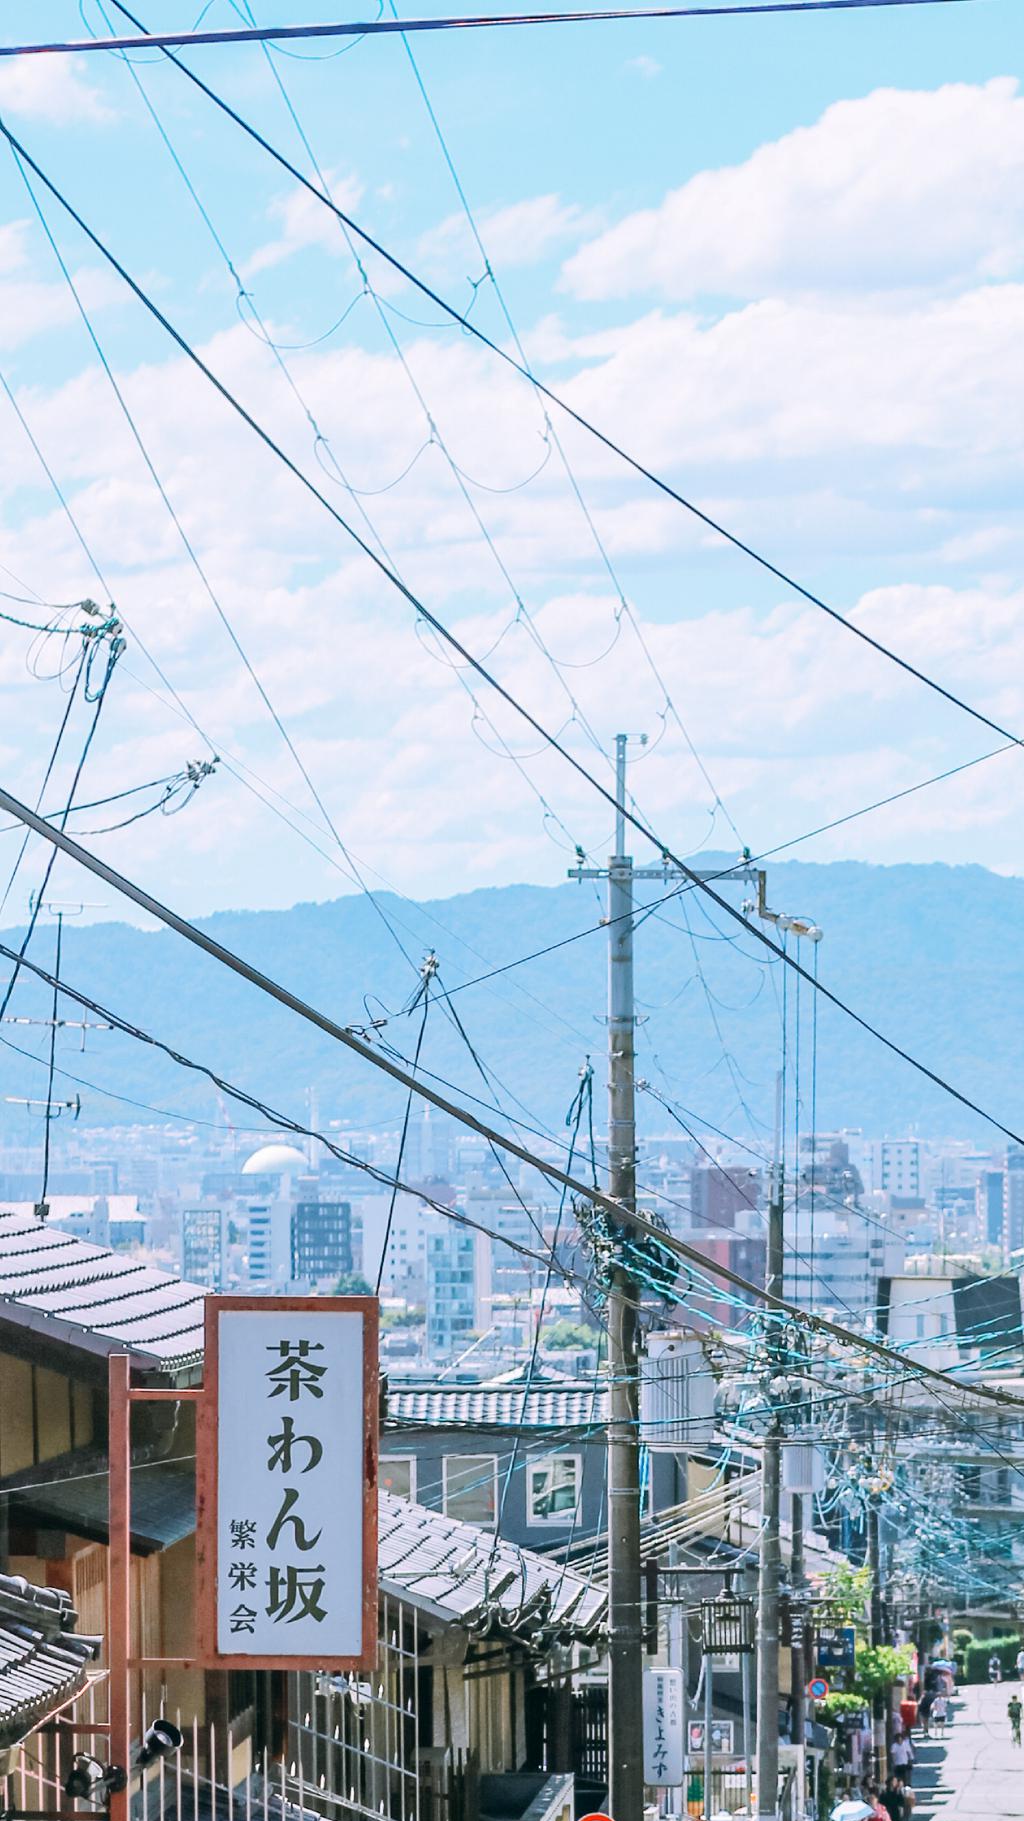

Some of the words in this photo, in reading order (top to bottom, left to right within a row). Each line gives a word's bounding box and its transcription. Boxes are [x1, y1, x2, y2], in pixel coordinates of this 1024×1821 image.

[228, 1519, 257, 1634] 繁栄会
[264, 1339, 328, 1624] 茶わん坂
